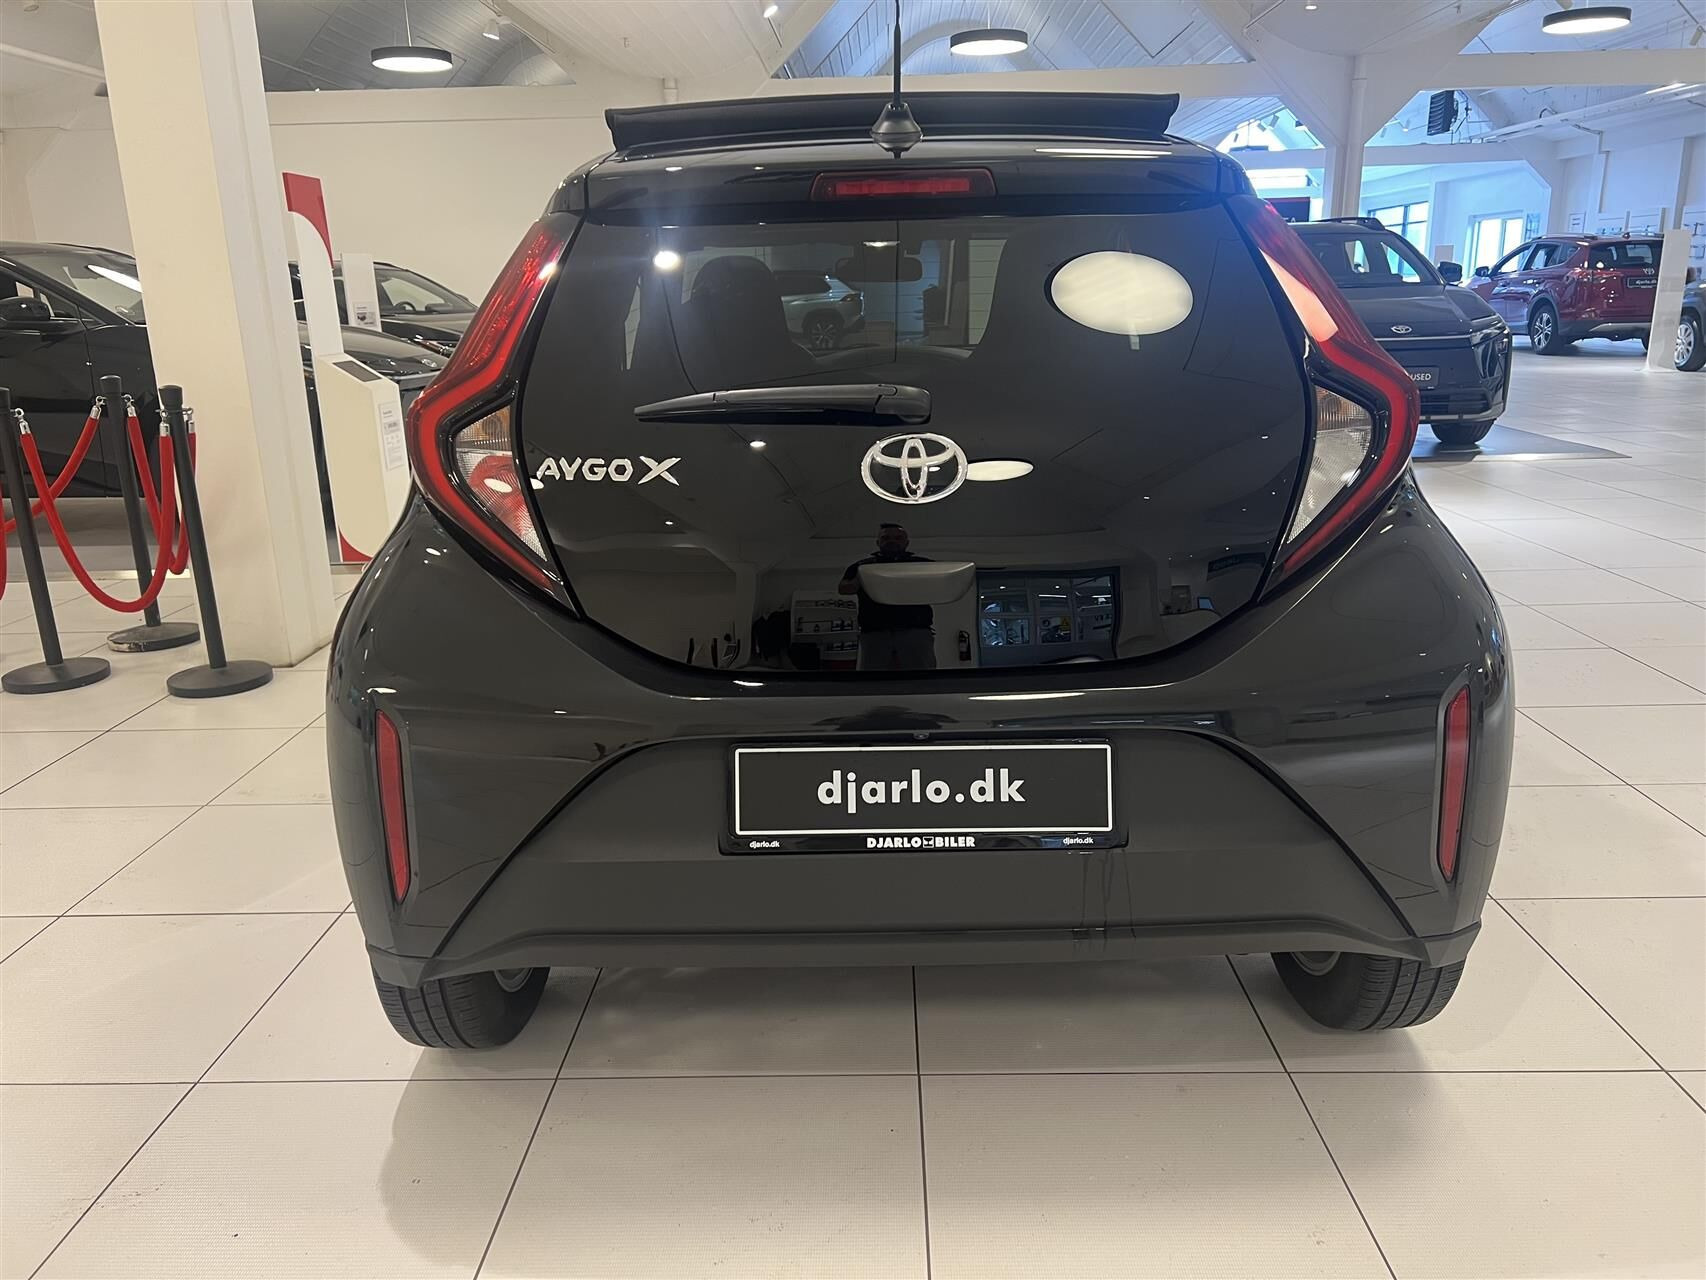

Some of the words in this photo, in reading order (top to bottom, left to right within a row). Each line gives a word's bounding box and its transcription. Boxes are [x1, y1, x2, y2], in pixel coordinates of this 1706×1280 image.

[536, 457, 634, 482] AYGO
[637, 455, 682, 486] X
[817, 768, 1026, 814] djarlo.dk
[749, 840, 780, 849] djarlo.dk
[866, 837, 922, 849] DJARLO
[934, 836, 976, 848] BILER
[1062, 837, 1094, 846] djarlo.dk
